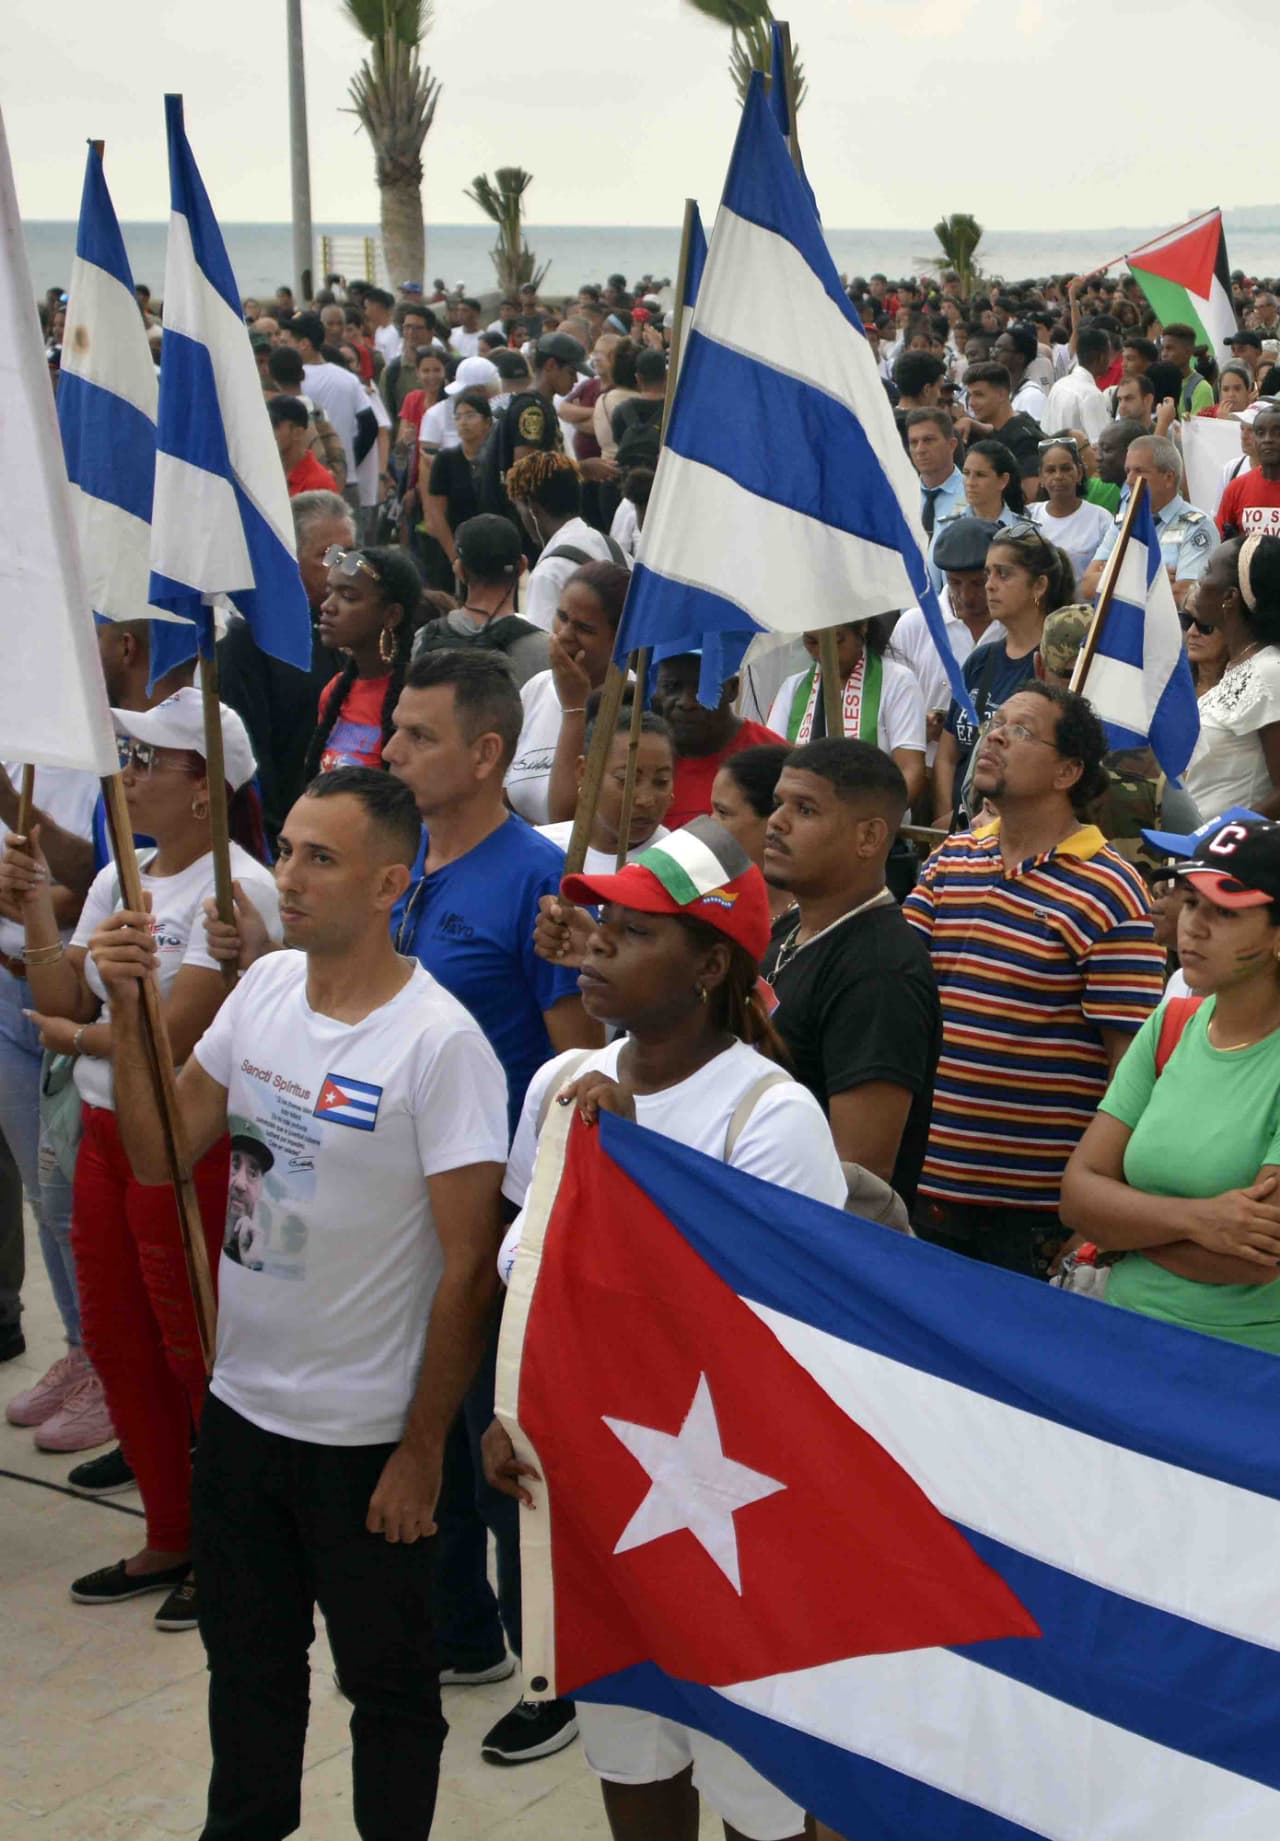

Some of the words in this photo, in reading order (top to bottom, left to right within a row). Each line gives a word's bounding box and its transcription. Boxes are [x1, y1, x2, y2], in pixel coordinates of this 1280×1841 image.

[1245, 510, 1263, 523] YO
[1209, 825, 1247, 856] C
[241, 1059, 273, 1083] Sancti
